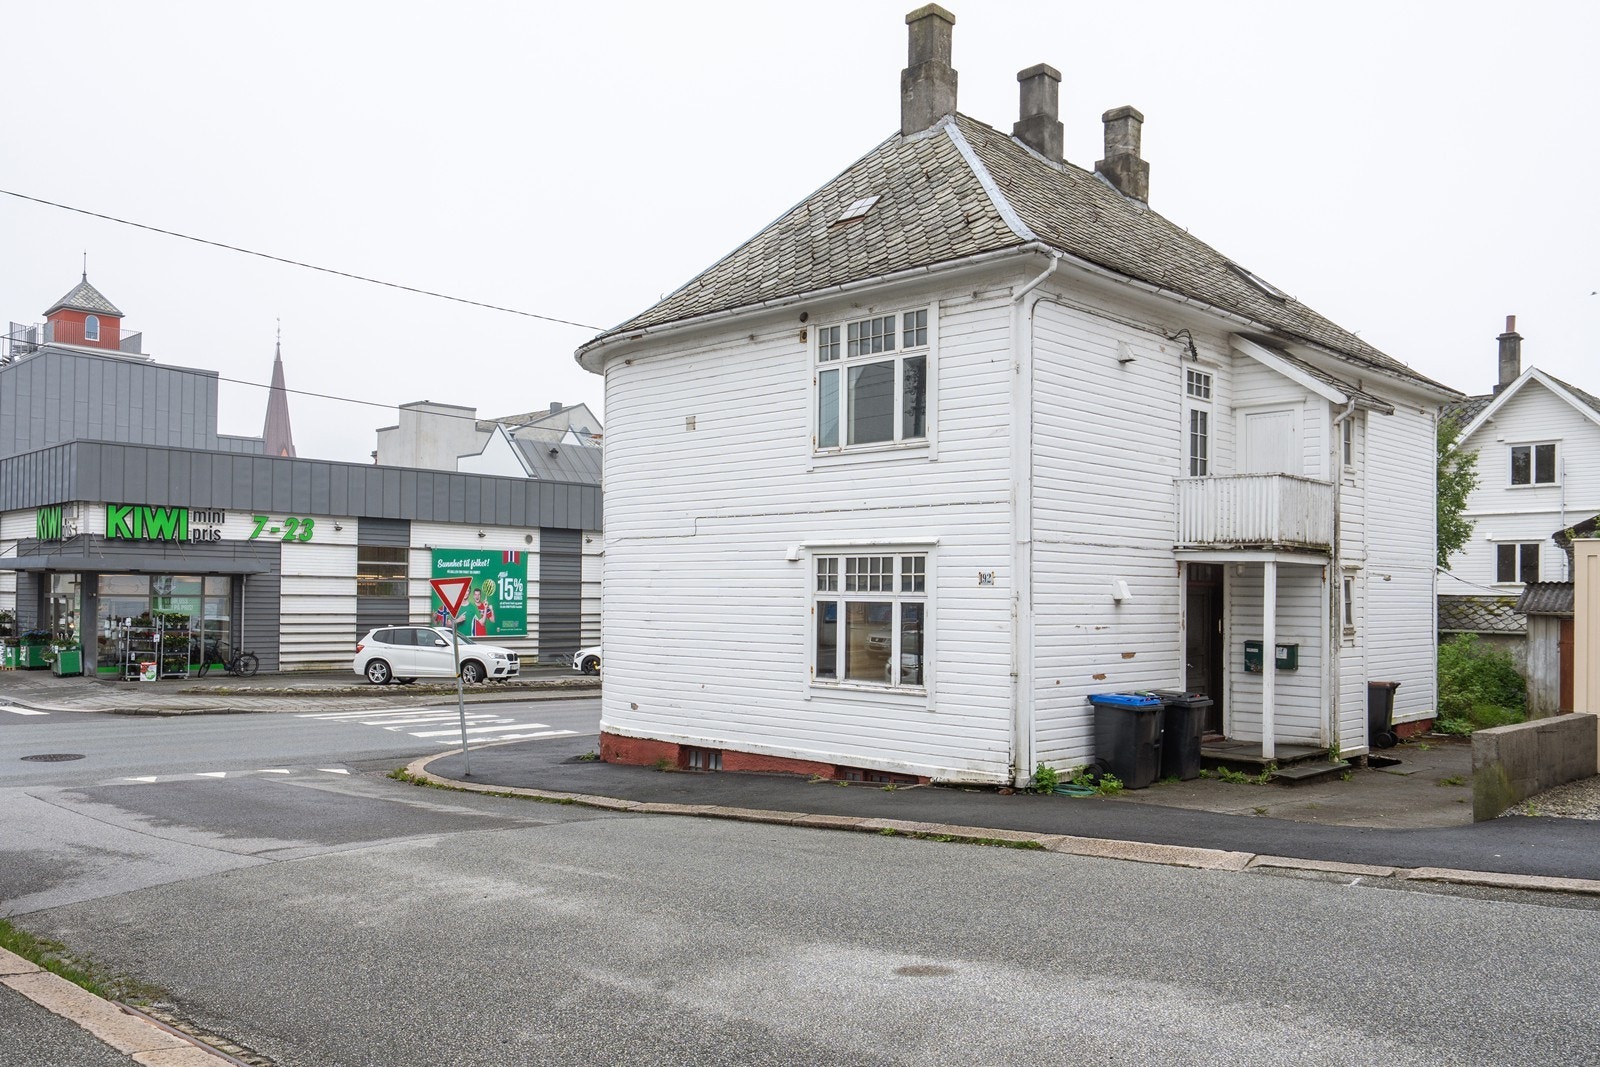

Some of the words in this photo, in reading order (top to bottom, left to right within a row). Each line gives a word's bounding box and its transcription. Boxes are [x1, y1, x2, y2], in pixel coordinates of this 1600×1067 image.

[36, 506, 62, 540] KIWI
[106, 503, 189, 541] KIWI
[192, 508, 225, 523] mini
[192, 525, 222, 542] pris
[497, 578, 523, 601] 15%
